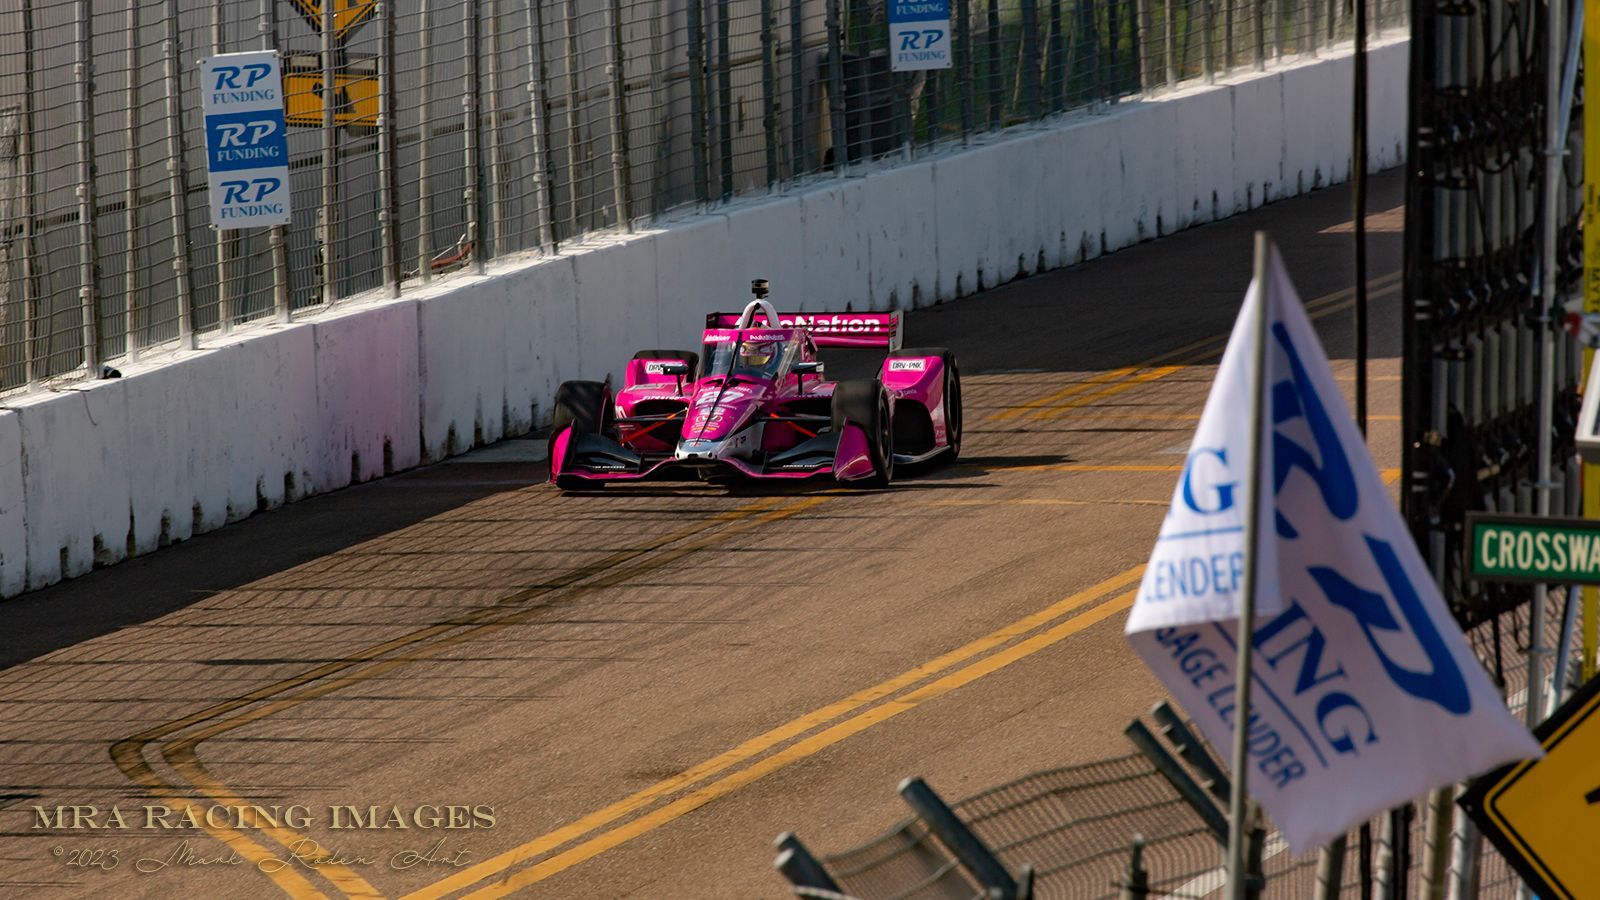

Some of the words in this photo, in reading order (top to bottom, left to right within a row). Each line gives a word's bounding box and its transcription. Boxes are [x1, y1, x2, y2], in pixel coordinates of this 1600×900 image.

[896, 3, 943, 15] FUNDING
[898, 29, 944, 50] RP
[898, 50, 945, 62] FUNDING
[211, 63, 272, 90] RP
[212, 89, 274, 104] FUNDING
[215, 120, 277, 147] RP
[217, 146, 279, 162] FUNDING
[220, 177, 281, 205] RP
[221, 203, 283, 219] FUNDING
[695, 391, 745, 407] 27
